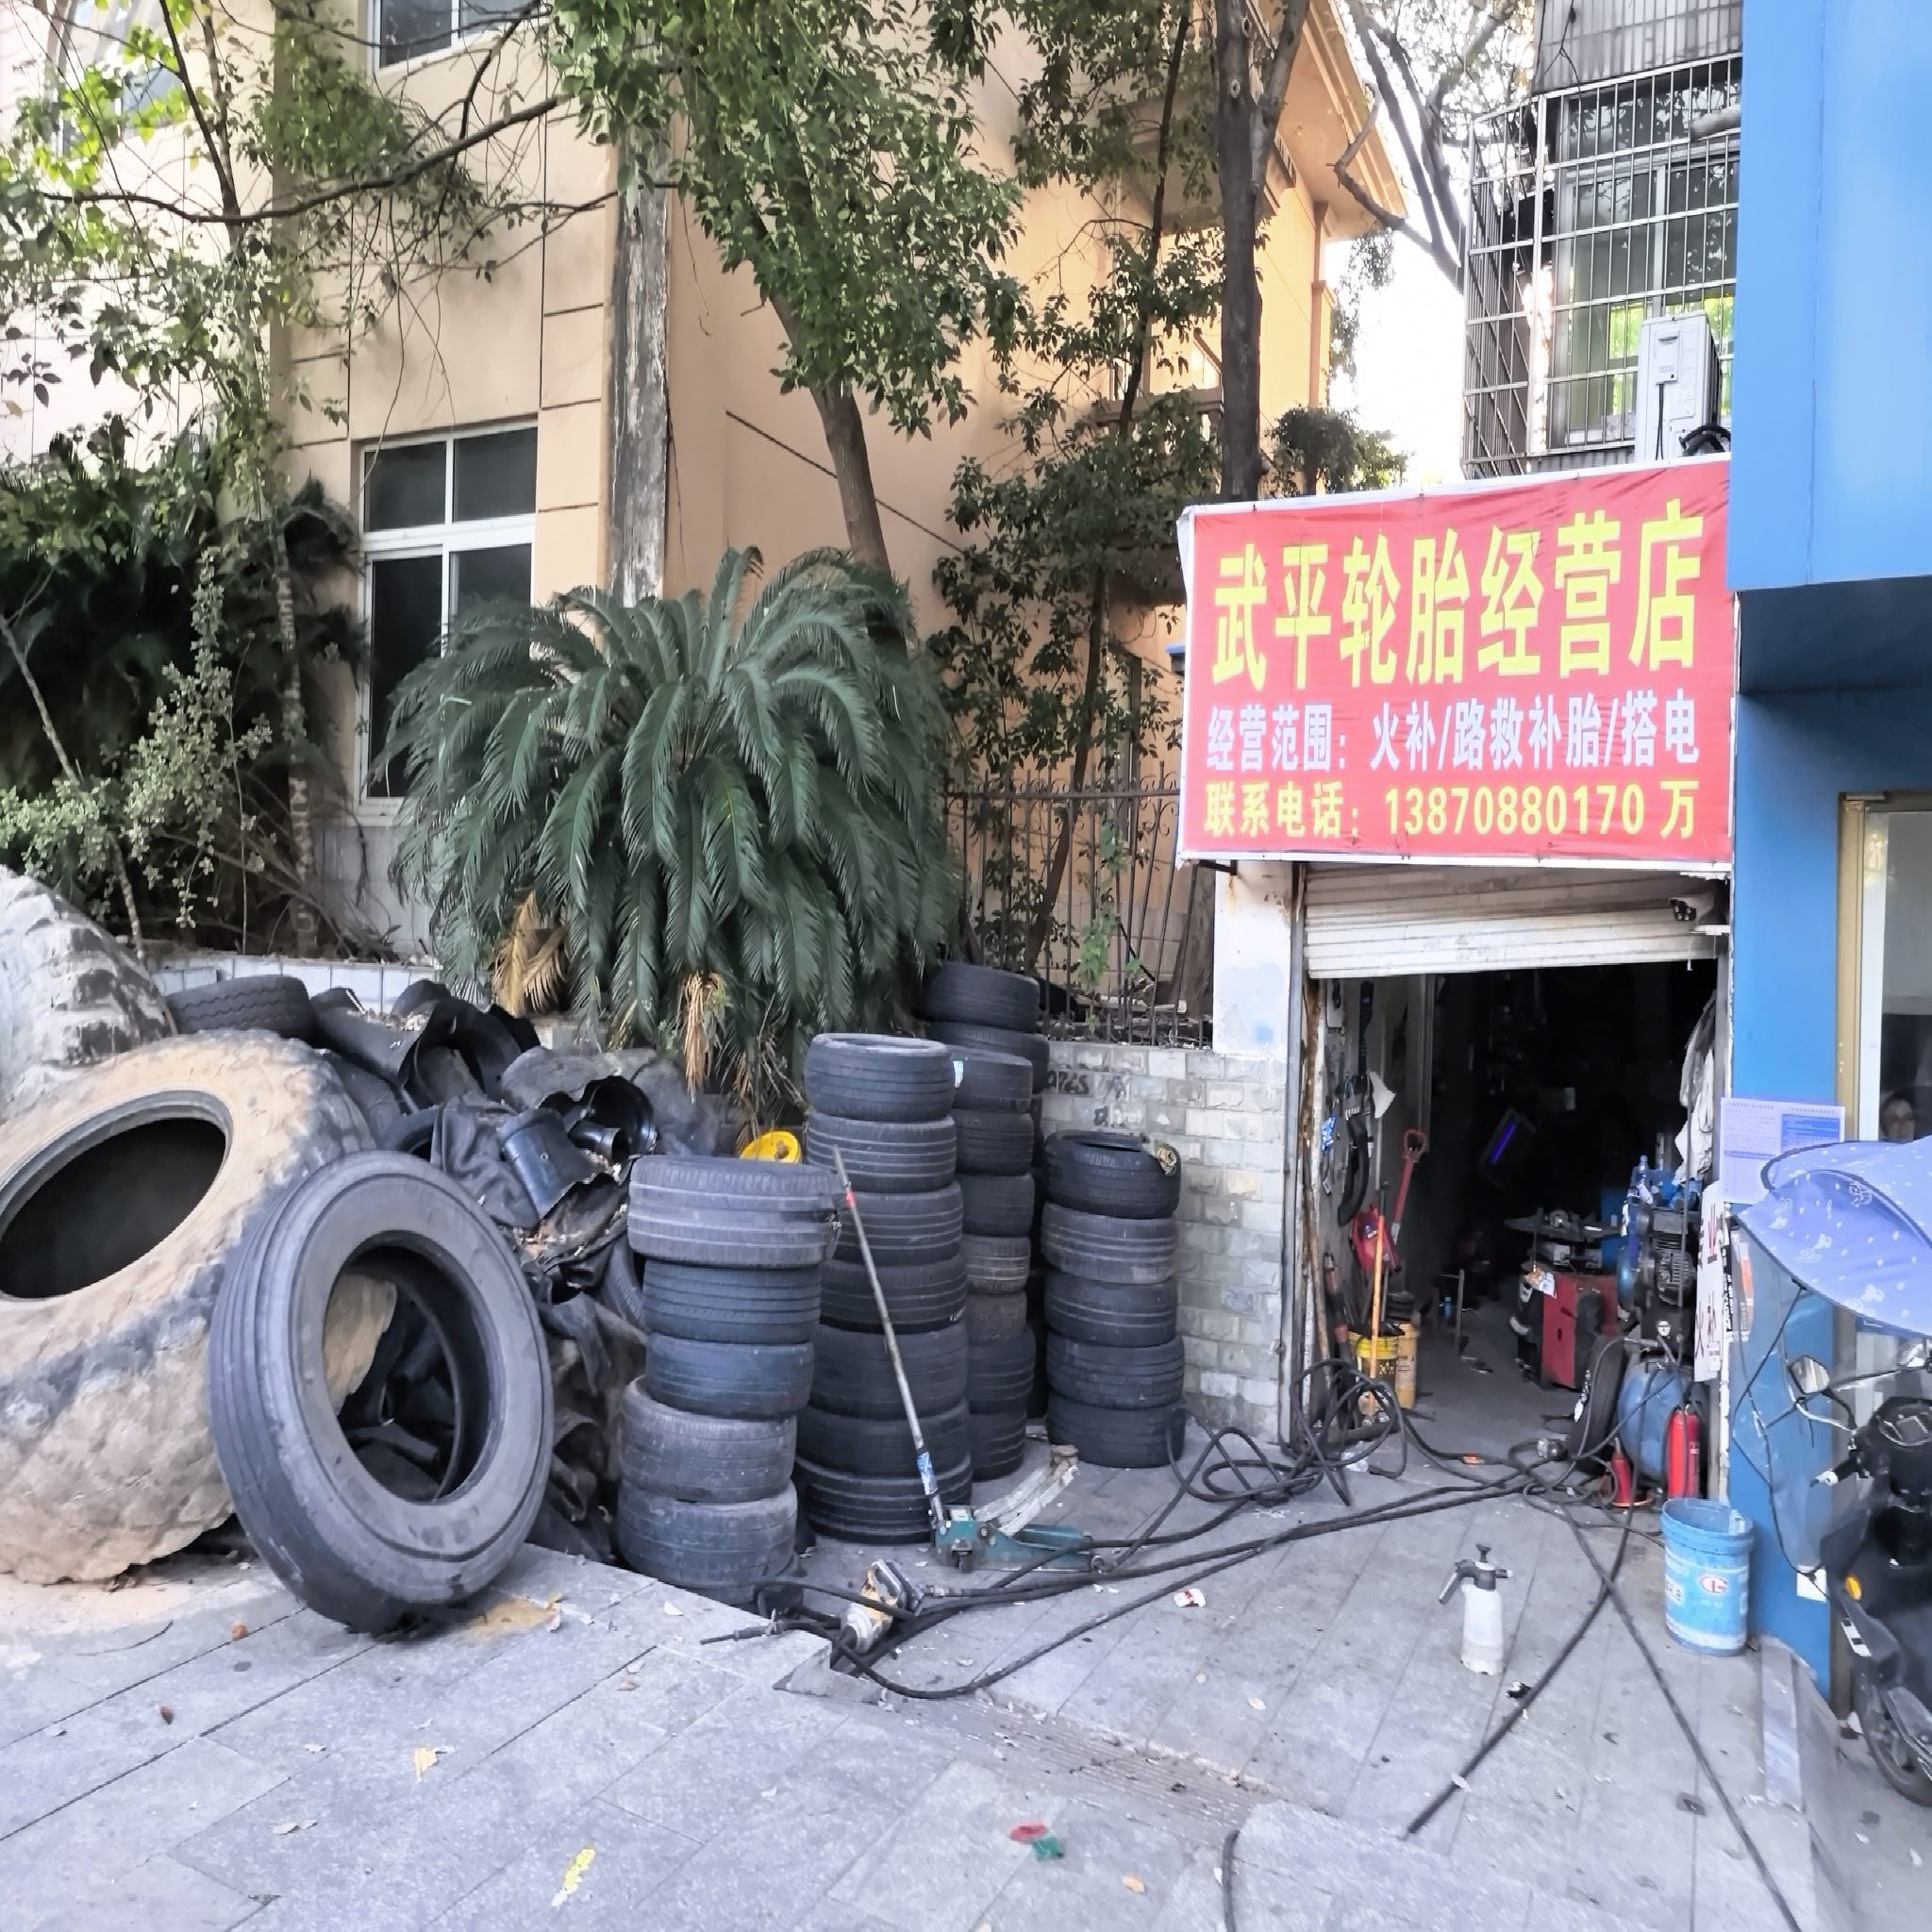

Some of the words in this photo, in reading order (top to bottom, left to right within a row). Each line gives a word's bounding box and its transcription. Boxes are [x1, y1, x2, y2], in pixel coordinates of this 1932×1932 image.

[1212, 498, 1703, 691] 武平轮胎经营店
[1370, 688, 1699, 773] 火补/路救补胎/搭电
[1384, 783, 1645, 836] 13870880170
[1659, 780, 1699, 840] 万
